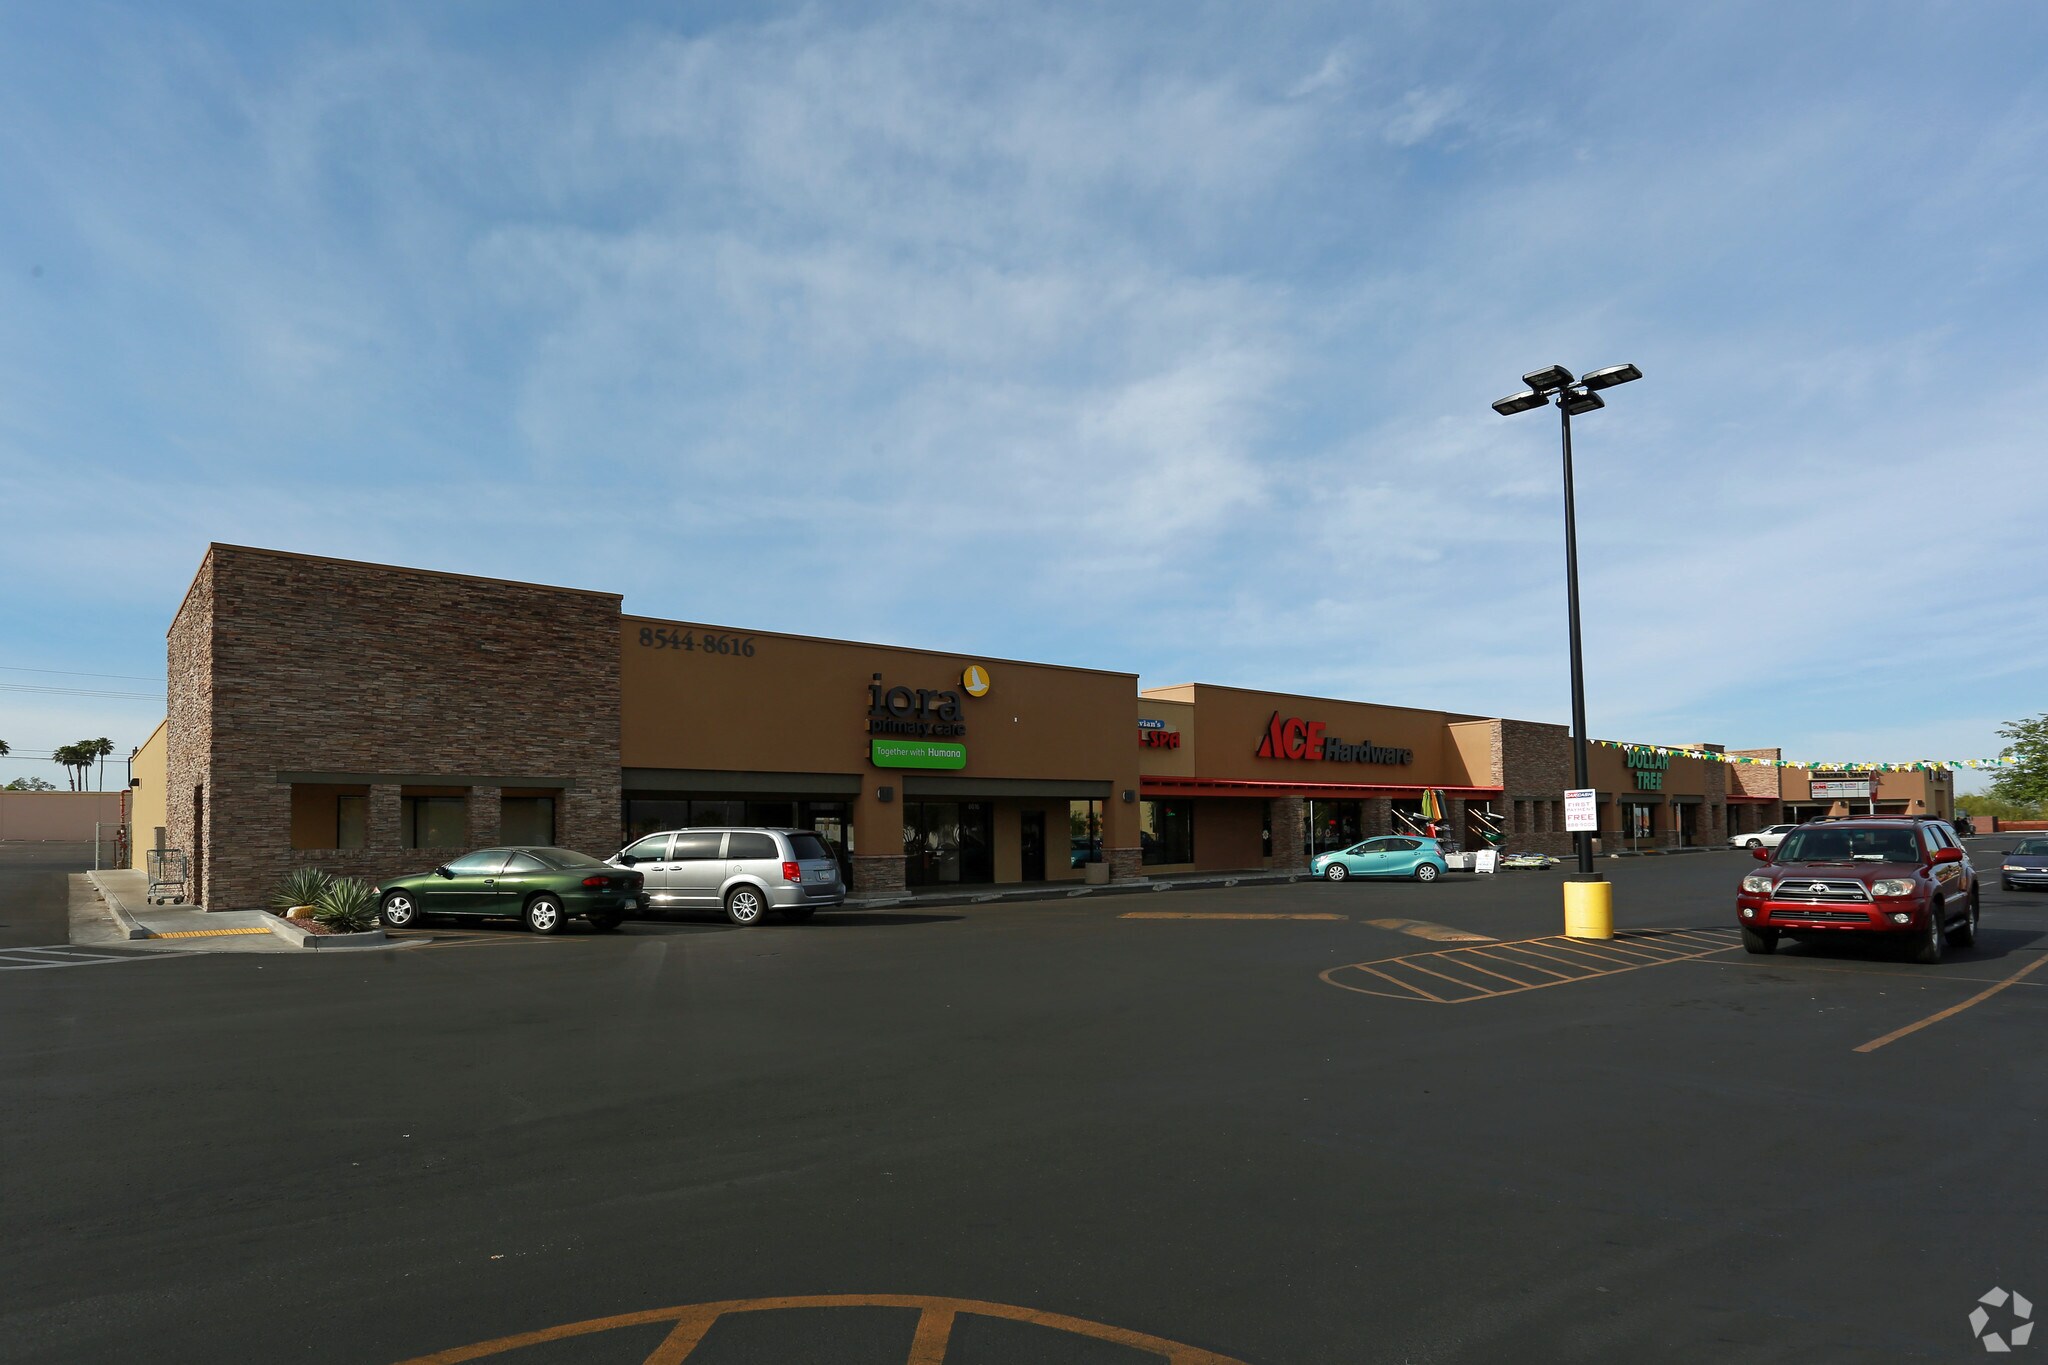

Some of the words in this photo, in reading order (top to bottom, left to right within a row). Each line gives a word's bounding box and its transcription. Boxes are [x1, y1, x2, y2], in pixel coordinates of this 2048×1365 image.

[639, 627, 756, 658] 8544-8616
[868, 672, 964, 721] iora
[870, 717, 930, 738] primary
[932, 723, 966, 737] care
[1138, 719, 1161, 728] vian's
[1148, 730, 1180, 750] SPA
[1257, 711, 1326, 760] ACE
[1325, 737, 1413, 765] Hardware
[877, 746, 908, 757] Together
[909, 748, 925, 757] with
[928, 748, 961, 758] Humana
[1627, 749, 1669, 770] DOLLAR
[1636, 771, 1663, 790] TREE
[1567, 813, 1594, 821] FREE
